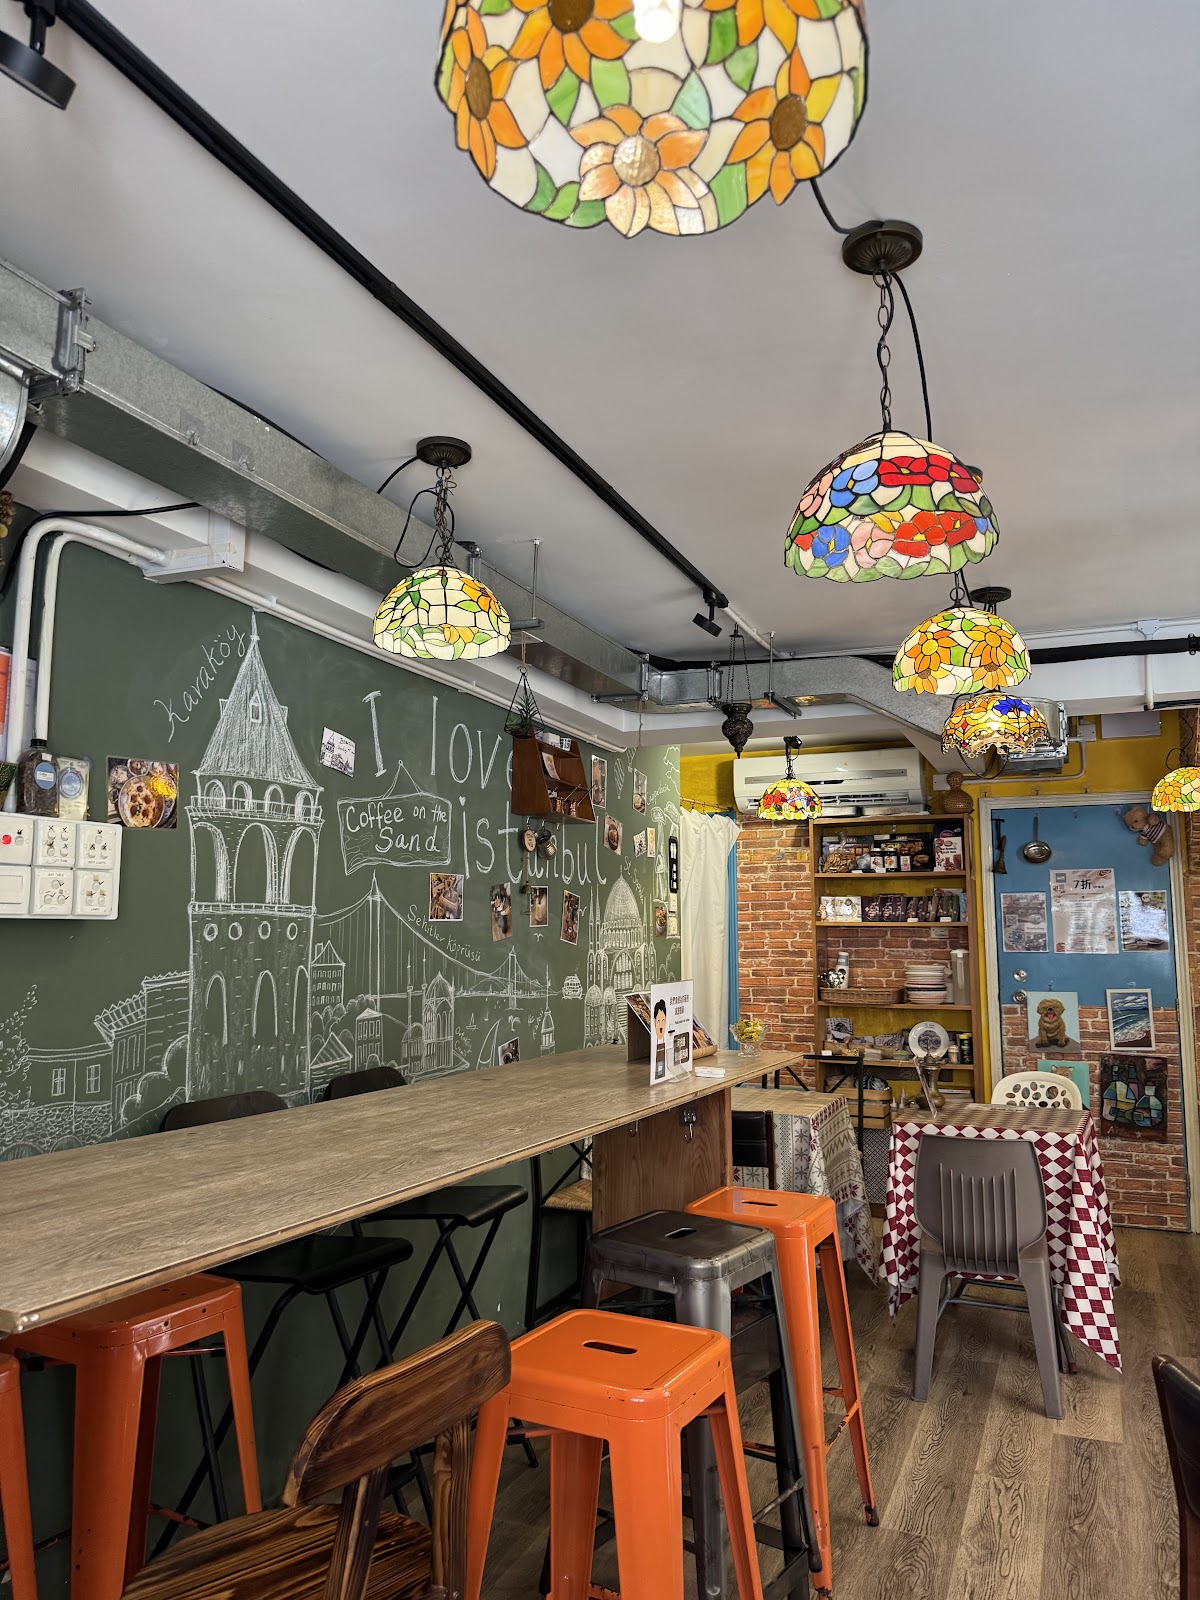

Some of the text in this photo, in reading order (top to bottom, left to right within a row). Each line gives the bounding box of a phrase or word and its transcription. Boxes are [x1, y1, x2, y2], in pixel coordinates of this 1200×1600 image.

[154, 625, 245, 742] Karaköy
[362, 690, 387, 777] I
[346, 802, 448, 832] Coffee on the
[375, 826, 441, 853] Sand
